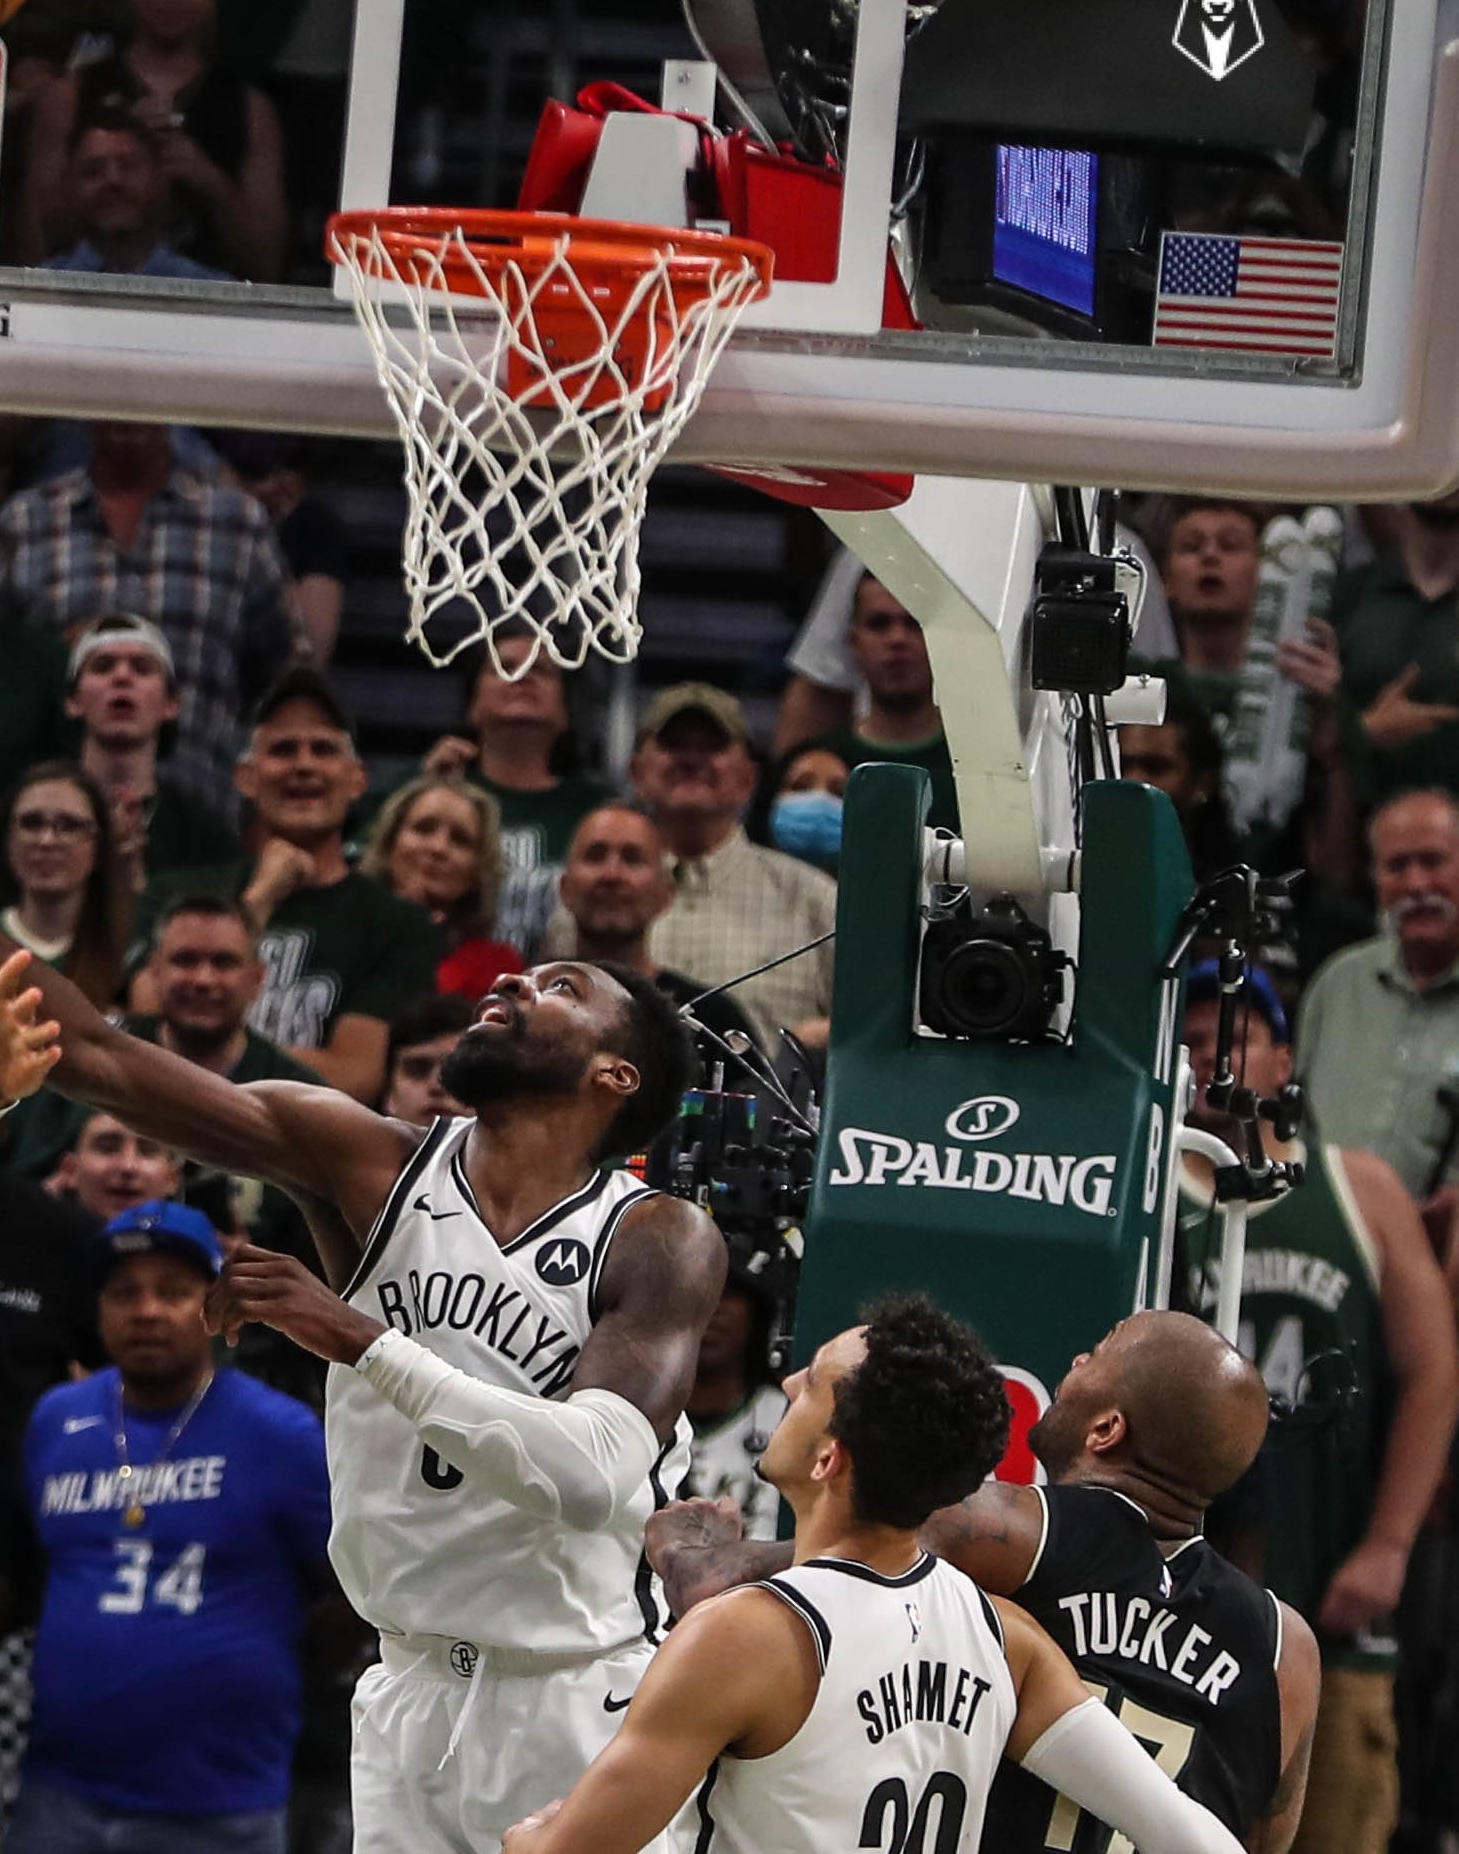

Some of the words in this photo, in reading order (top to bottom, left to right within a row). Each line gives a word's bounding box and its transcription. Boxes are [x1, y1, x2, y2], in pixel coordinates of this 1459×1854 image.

[829, 1127, 1117, 1217] SPALDING
[377, 1269, 582, 1399] BROOKLYN
[97, 1540, 207, 1616] 34
[1058, 1592, 1242, 1707] TUCKER
[856, 1660, 992, 1745] SHAMET
